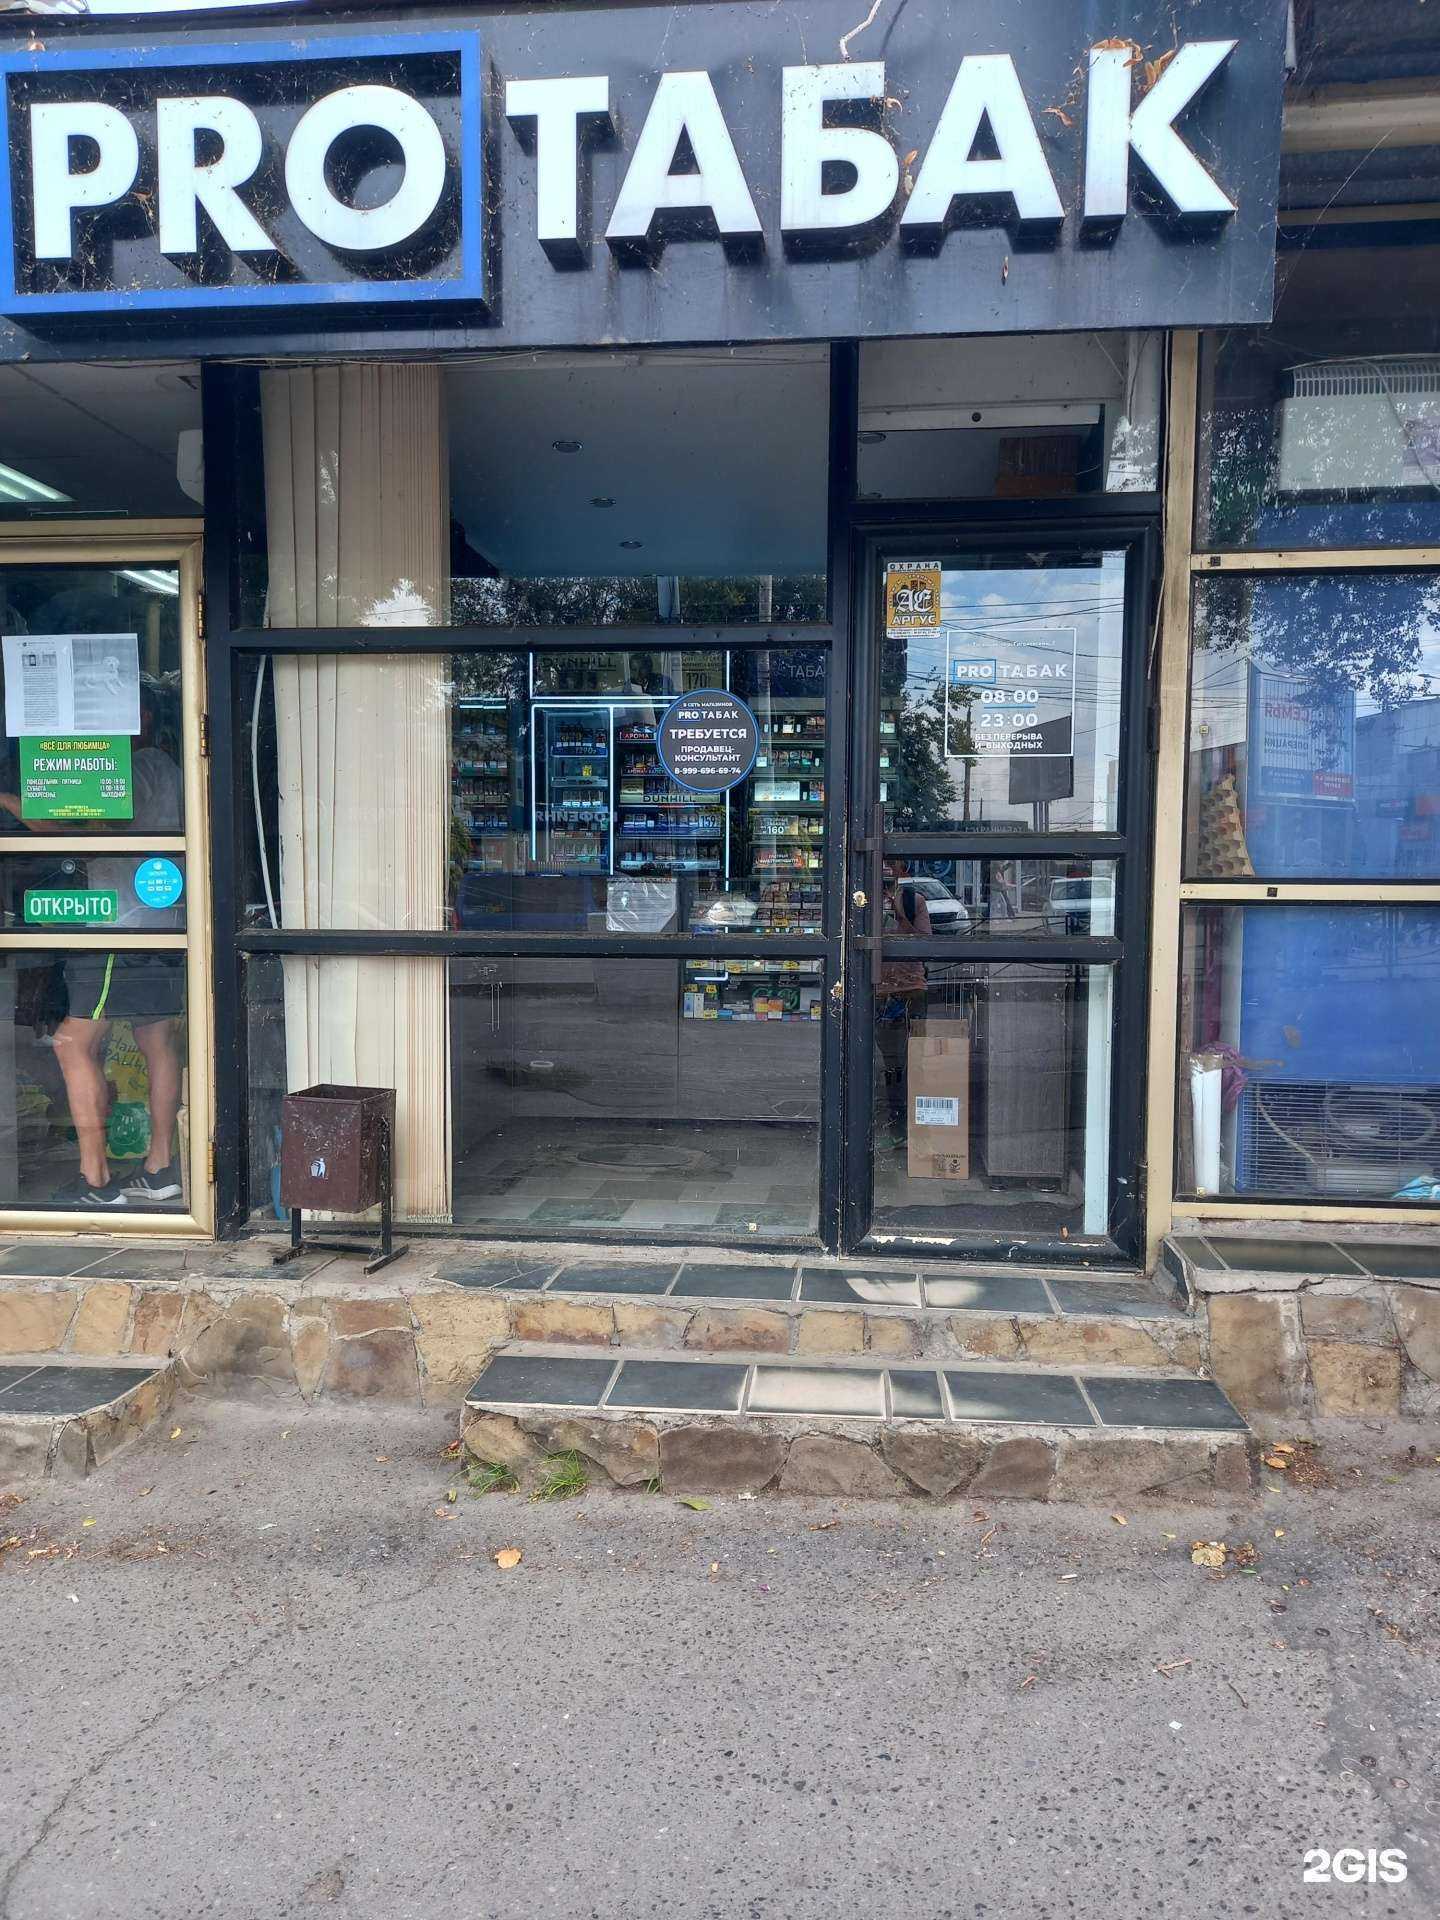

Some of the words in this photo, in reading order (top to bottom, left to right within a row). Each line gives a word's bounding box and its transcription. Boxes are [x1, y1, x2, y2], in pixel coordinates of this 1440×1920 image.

[30, 85, 446, 259] PRO
[505, 40, 1239, 242] ТАБАК
[889, 562, 939, 570] ОХРАНА
[891, 614, 936, 625] АРГУС
[957, 663, 993, 678] PRO
[1000, 663, 1068, 678] ТАБАК
[981, 689, 1039, 704] 08:00
[678, 711, 699, 719] PRO
[701, 710, 739, 719] ТАБАК
[980, 713, 1038, 728] 23:00
[669, 728, 747, 739] ТРЕБУЕТСЯ
[975, 733, 992, 741] БЕЗ
[993, 733, 1043, 741] ПЕРЕРЫВА
[681, 745, 735, 753] ПРОДАВЕЦ-
[986, 741, 1043, 750] ВЫХОДНЫХ
[675, 754, 741, 762] КОНСУЛЬТАНТ
[33, 758, 72, 771] РЕЖИМ
[74, 758, 118, 771] РАБОТЫ:
[674, 767, 742, 775] 8-999-696-69-74
[642, 793, 696, 803] DUNHILL
[767, 826, 785, 834] 160
[30, 897, 112, 916] ОТКРЫТО
